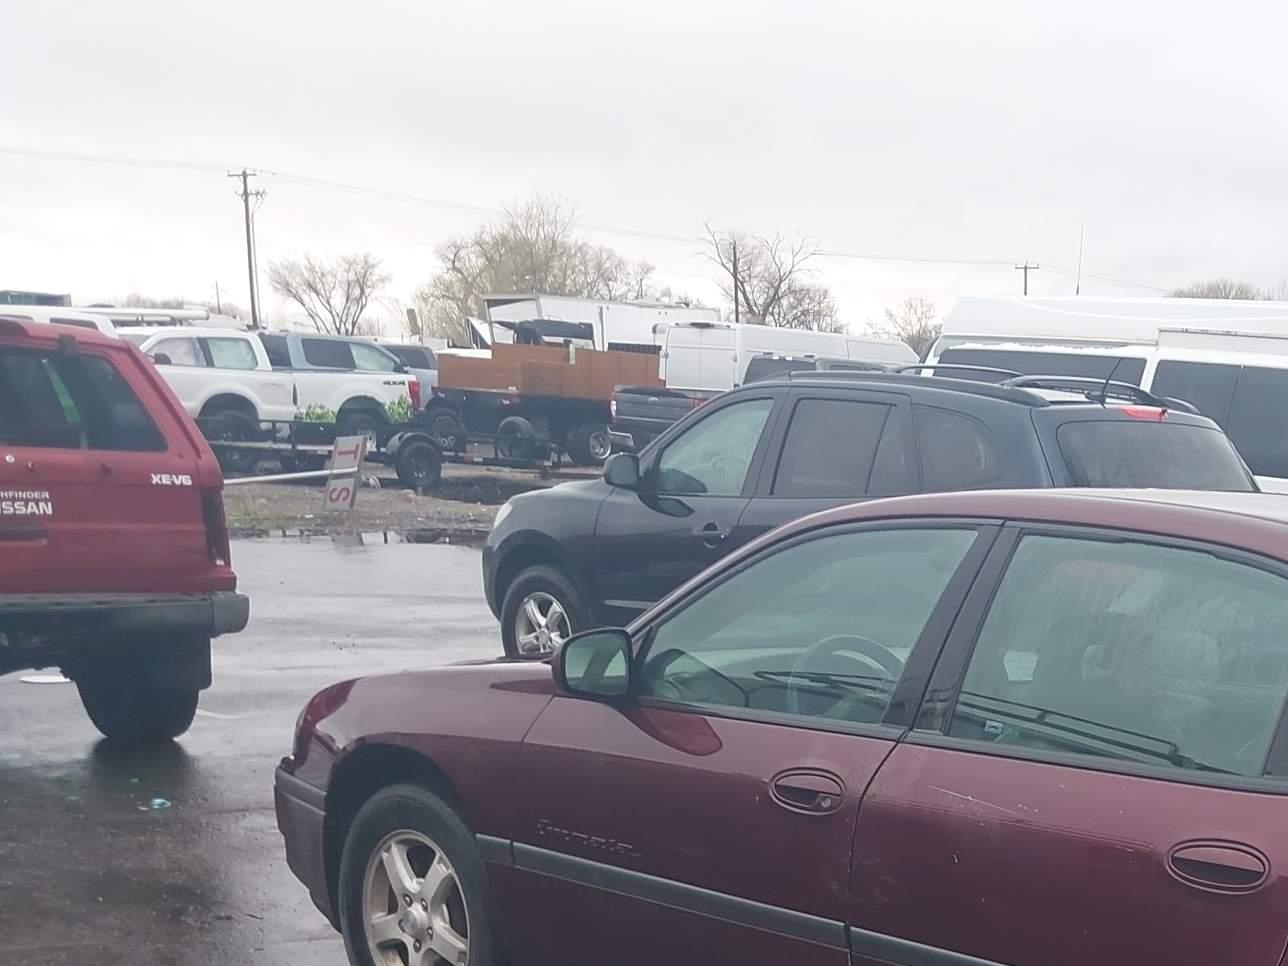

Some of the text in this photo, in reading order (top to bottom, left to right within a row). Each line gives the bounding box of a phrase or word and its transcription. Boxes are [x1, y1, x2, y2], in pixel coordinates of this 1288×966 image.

[337, 443, 361, 461] T
[0, 491, 49, 500] HFINDER
[328, 486, 351, 503] S
[0, 501, 53, 515] SSAN
